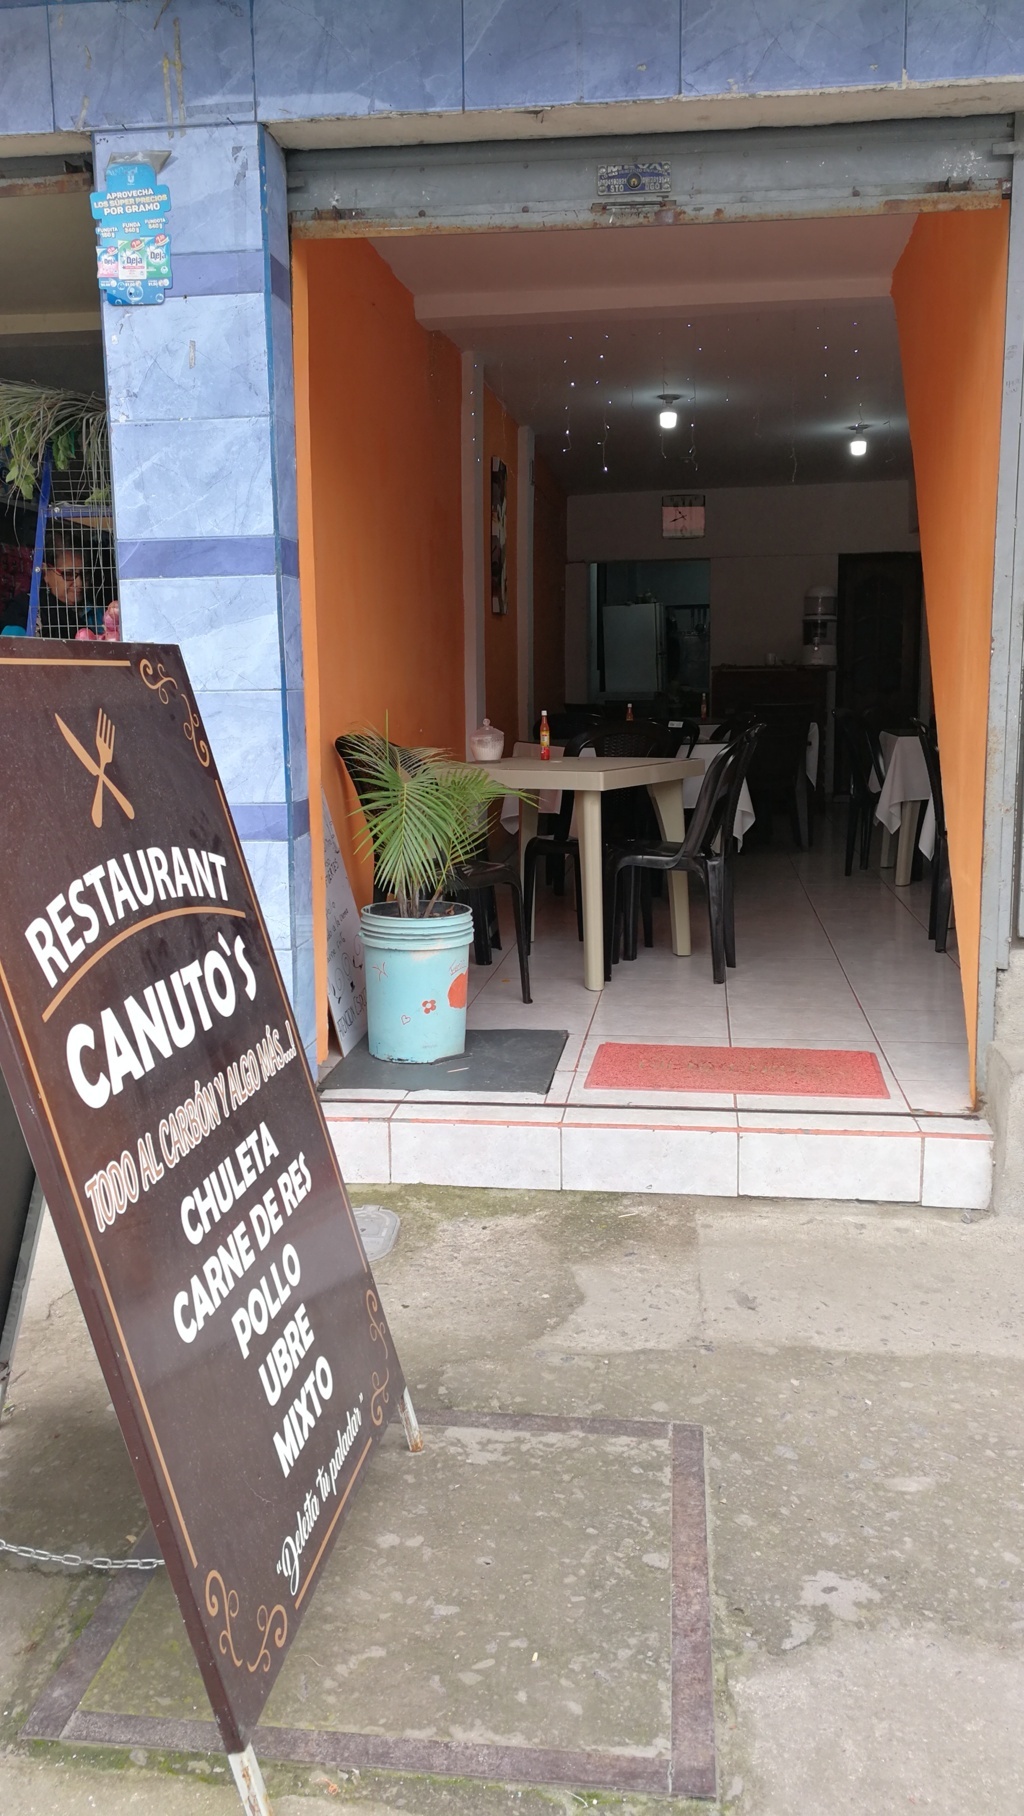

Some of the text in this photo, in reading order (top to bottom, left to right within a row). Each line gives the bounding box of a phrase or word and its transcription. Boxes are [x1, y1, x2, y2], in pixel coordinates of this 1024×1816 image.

[94, 194, 168, 209] LOS SÚPER PRECIOS
[104, 202, 160, 216] POR GRAMO
[106, 188, 154, 200] APROVECHA
[126, 256, 143, 266] Deja
[150, 251, 166, 261] Deja
[24, 846, 229, 988] RESTAURANT
[66, 931, 257, 1109] CANUTO'S
[85, 1150, 139, 1233] TODO
[137, 1132, 164, 1191] AL
[159, 1080, 221, 1168] CARBÓN
[213, 1072, 230, 1118] Y
[226, 1049, 261, 1111] ALGO
[180, 1121, 280, 1245] CHULETA
[173, 1151, 312, 1343] CARNE DE RES
[231, 1243, 301, 1360] POLLO
[258, 1302, 315, 1407] UBRE
[272, 1355, 333, 1478] MIXTO
[315, 1465, 331, 1502] tu
